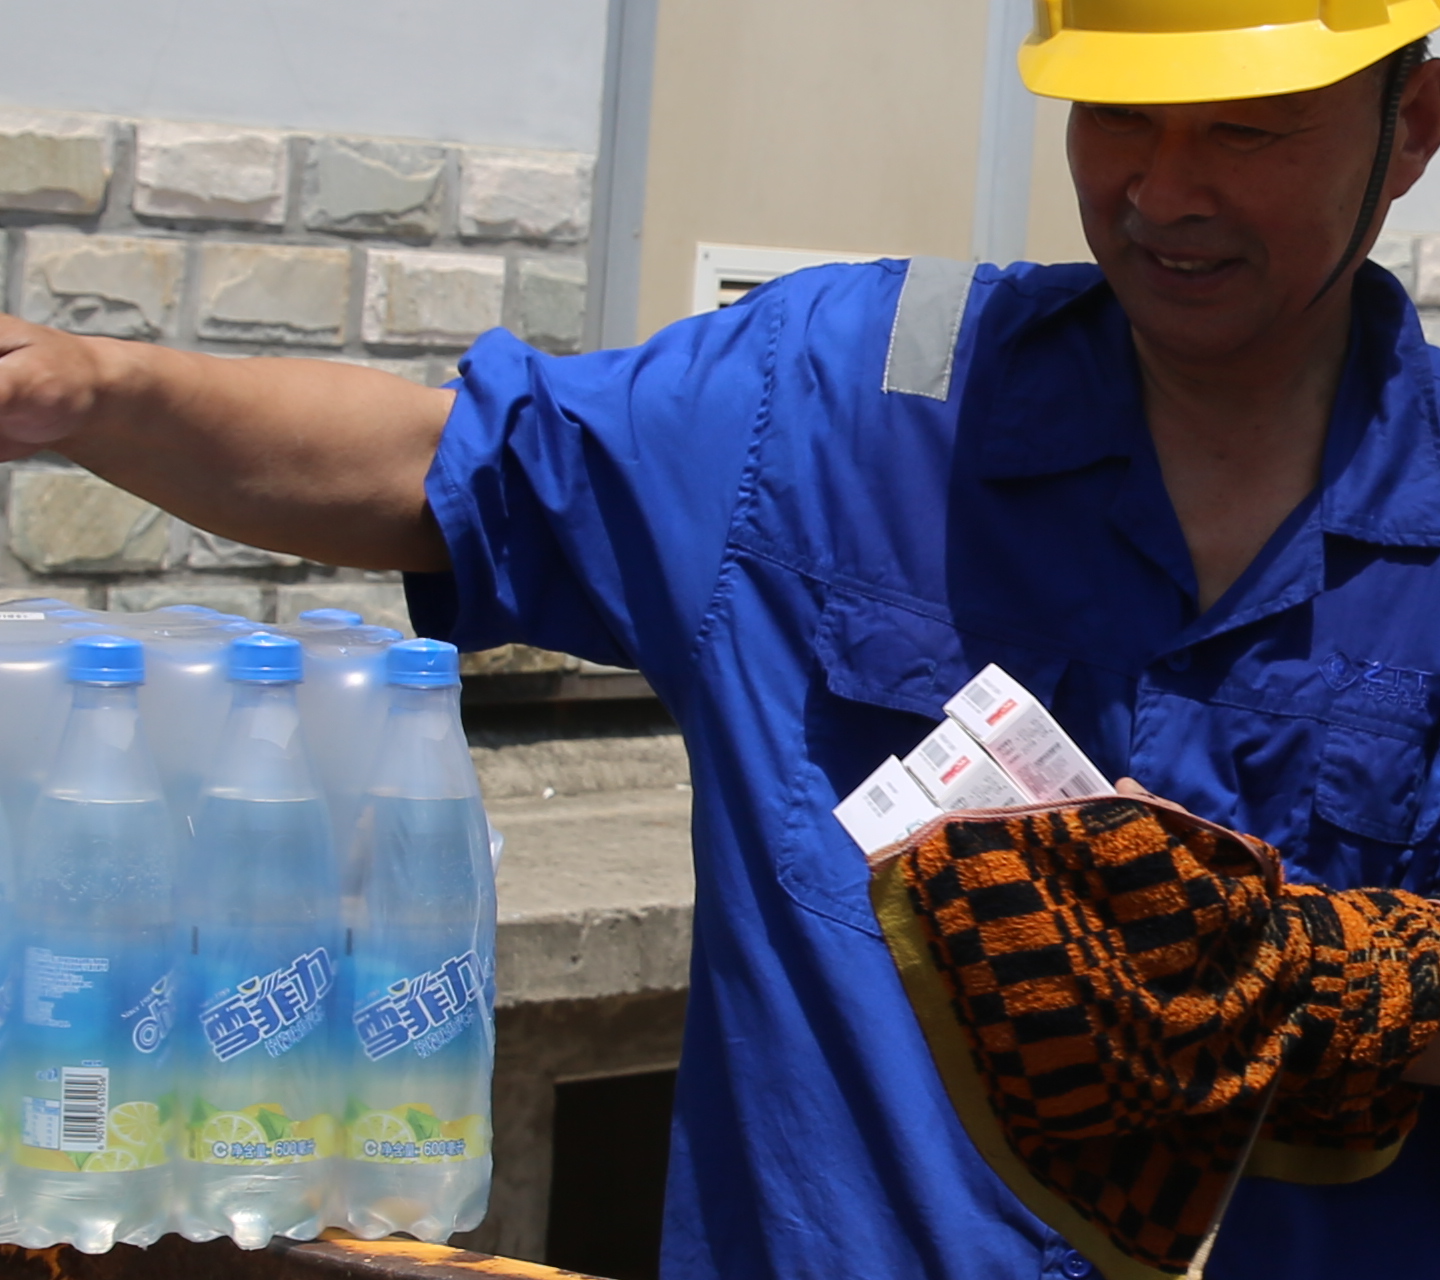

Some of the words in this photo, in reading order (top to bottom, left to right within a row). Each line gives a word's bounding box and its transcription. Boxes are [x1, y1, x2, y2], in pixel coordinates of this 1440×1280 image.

[1361, 658, 1434, 691] ZTT
[200, 947, 334, 1062] 雪菲力
[353, 950, 486, 1062] 雪菲力
